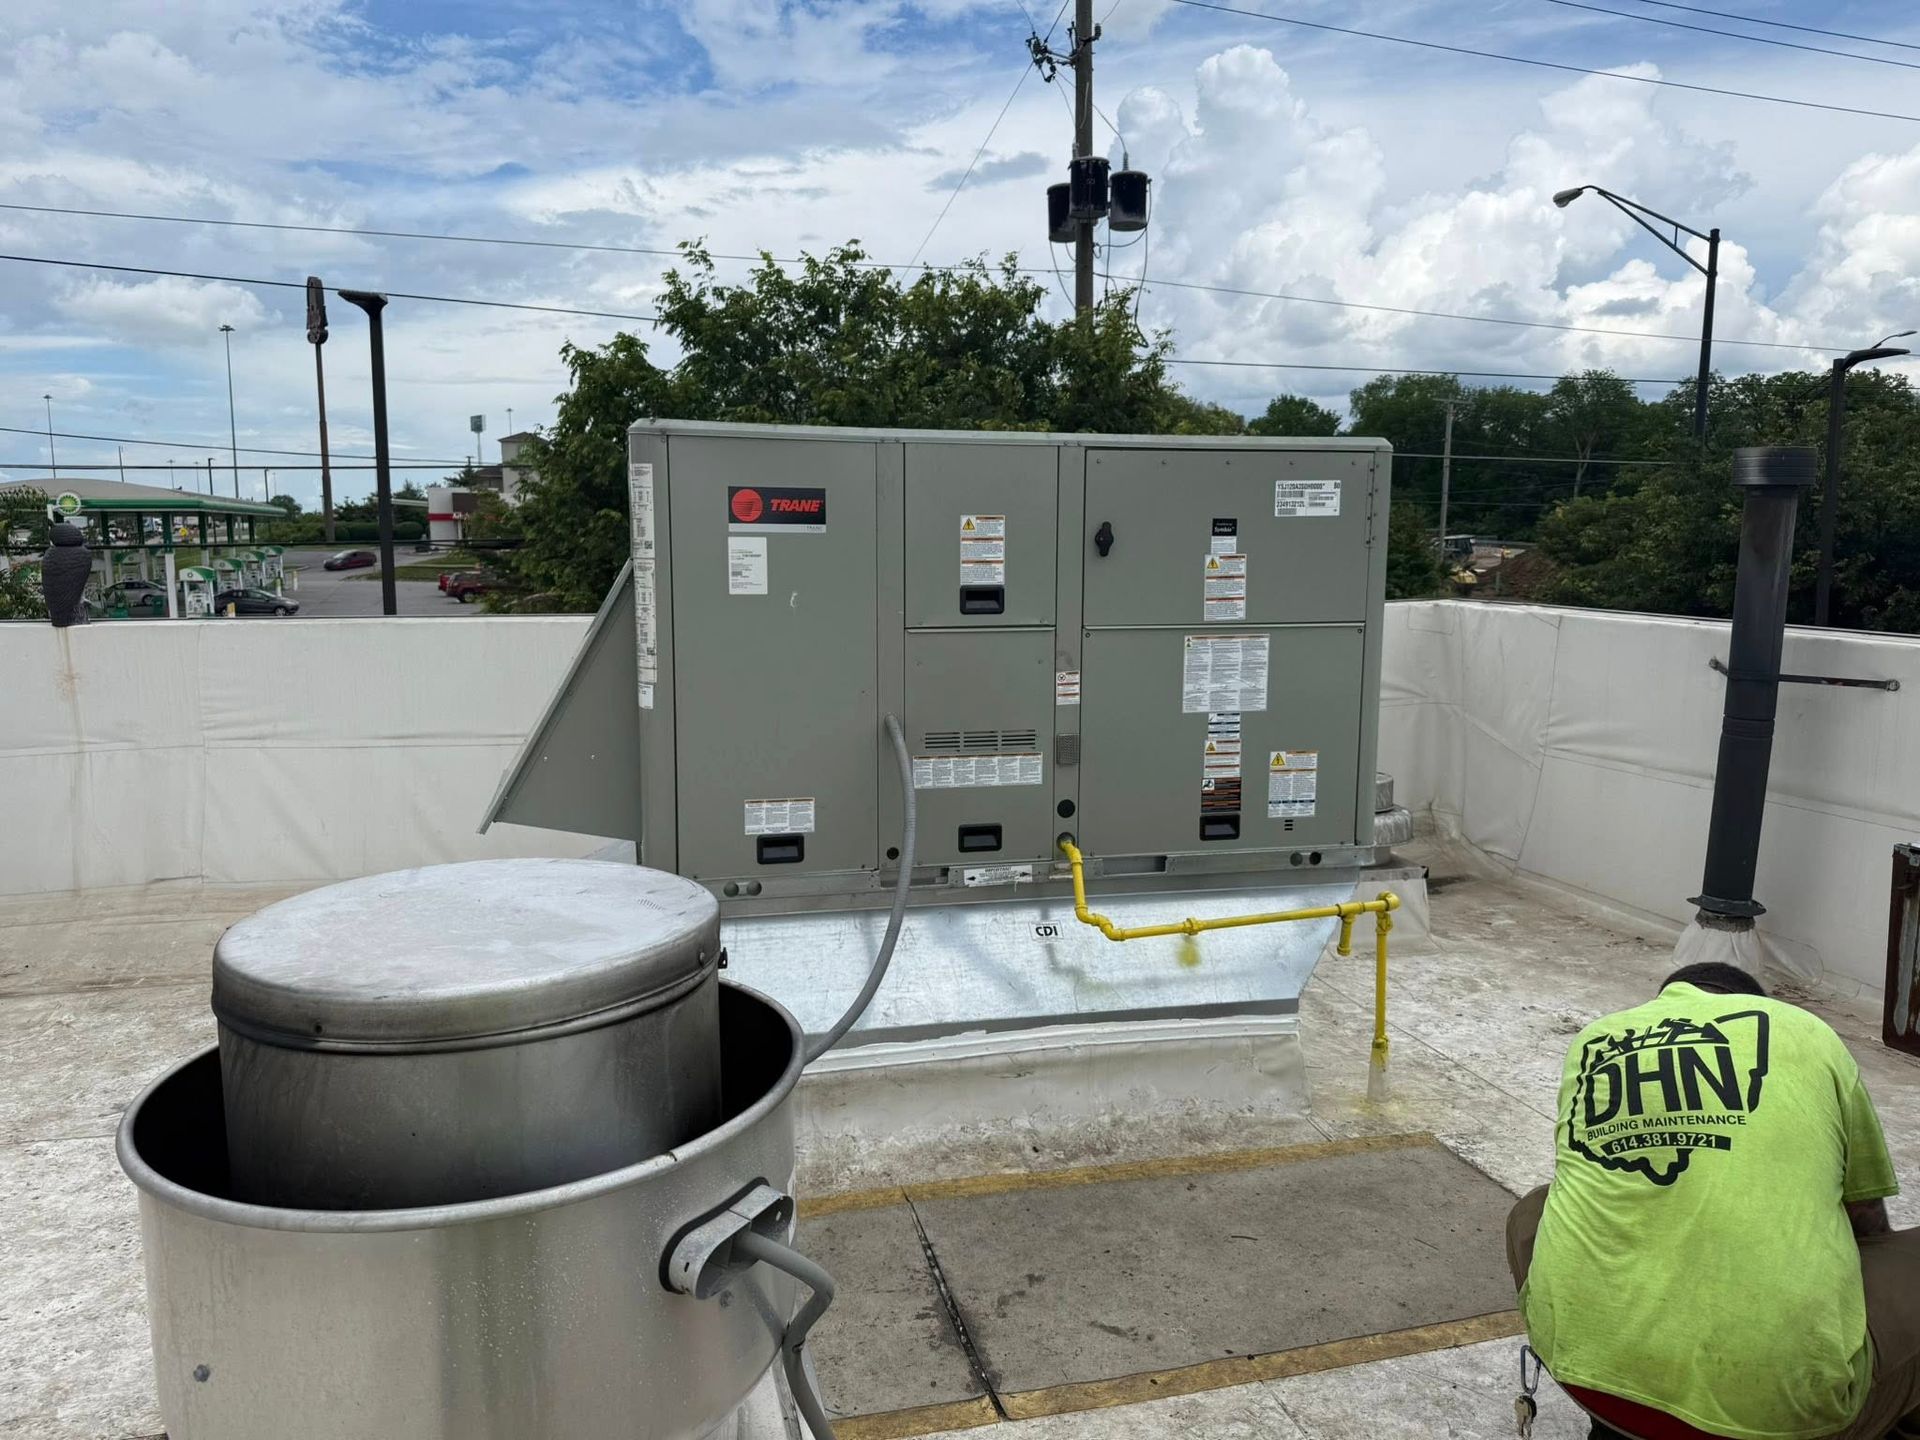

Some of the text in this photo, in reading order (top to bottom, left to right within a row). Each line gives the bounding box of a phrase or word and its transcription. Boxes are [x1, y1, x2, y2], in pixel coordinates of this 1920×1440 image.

[770, 498, 820, 512] TRANE
[1035, 925, 1058, 937] CDI
[1586, 1046, 1744, 1129] DHN
[1587, 1114, 1746, 1141] BUILDING MAINTENANCE
[1611, 1134, 1717, 1153] 614.381.9721
